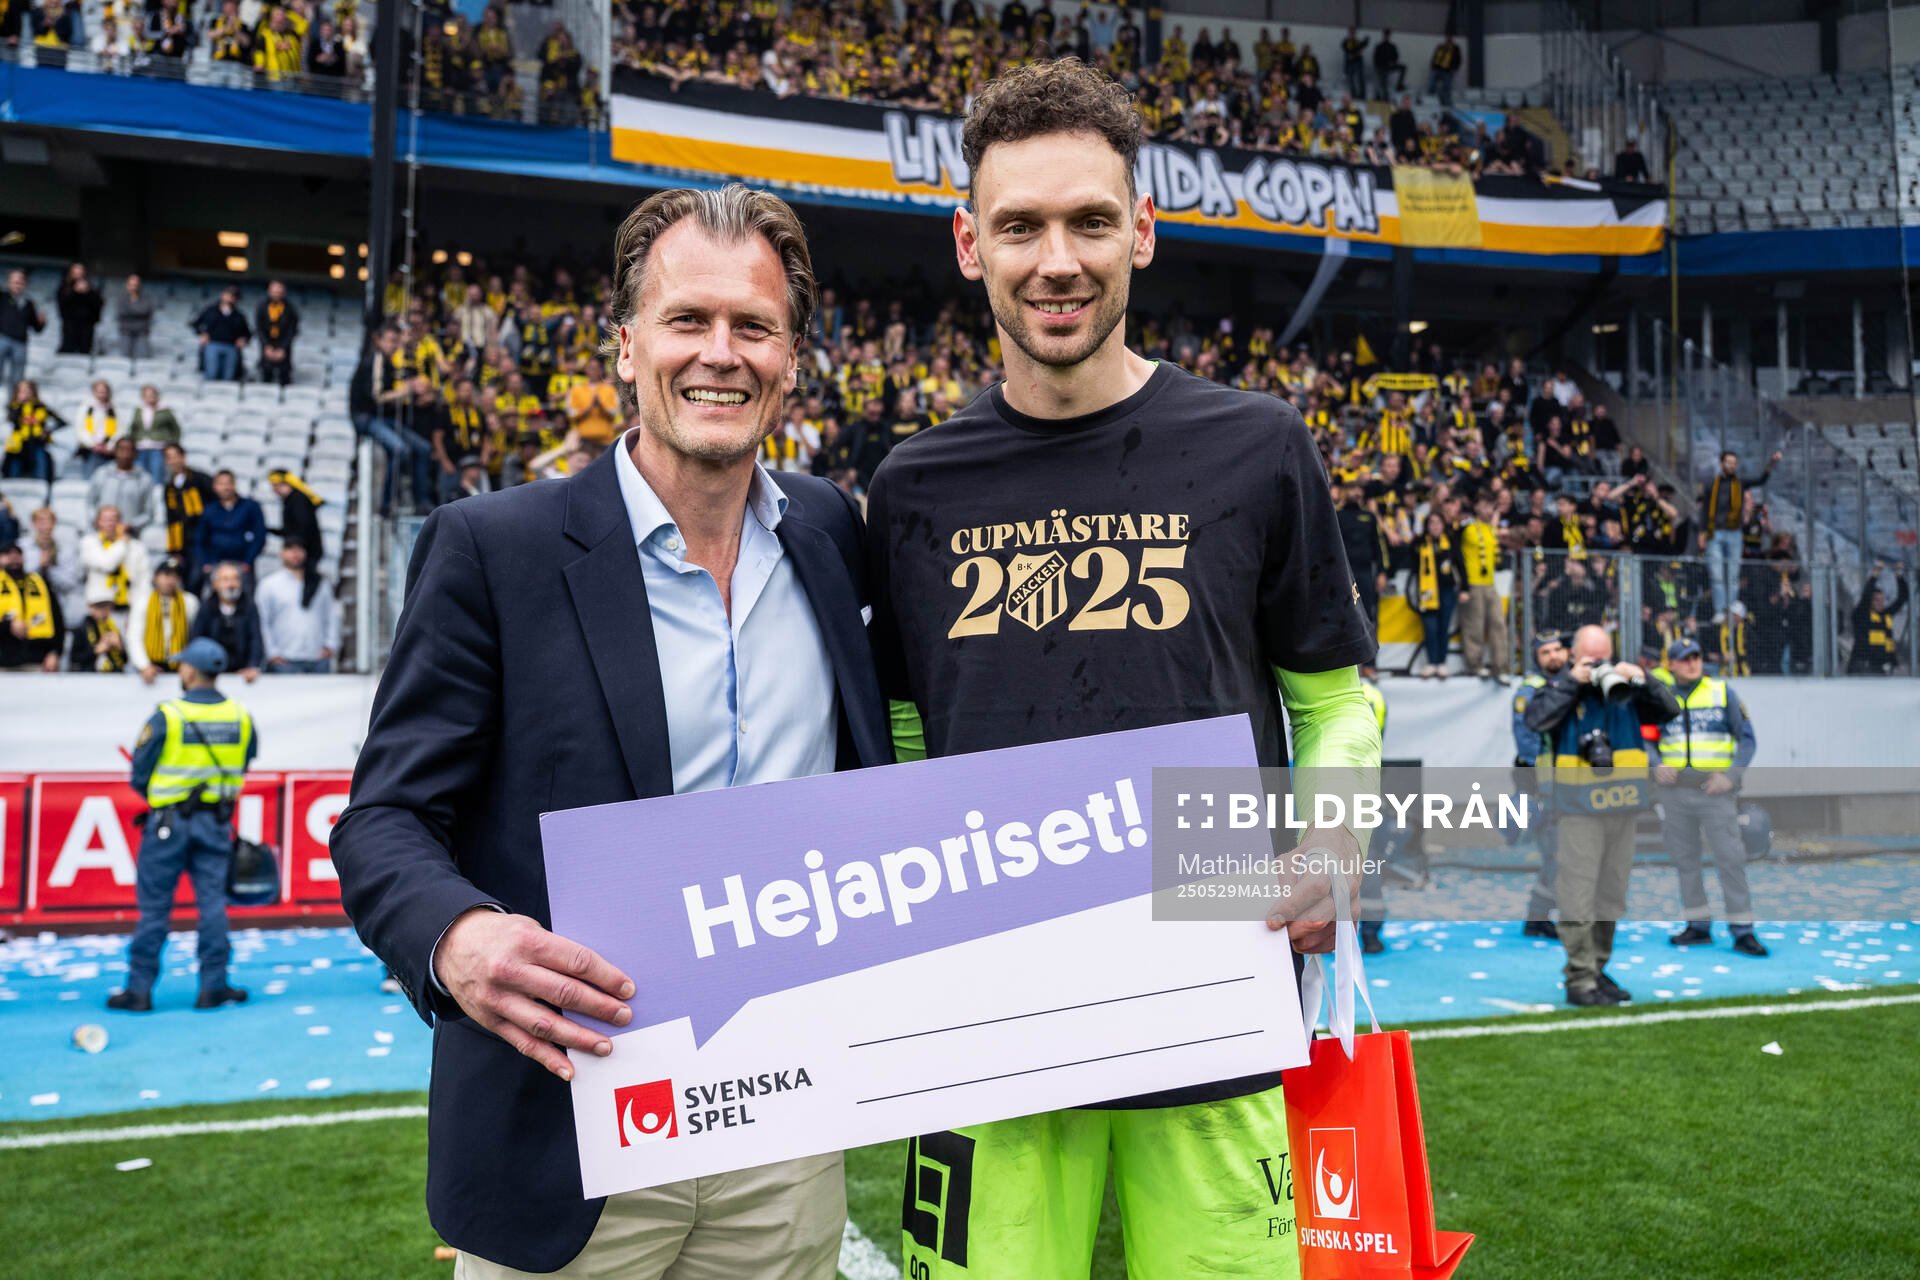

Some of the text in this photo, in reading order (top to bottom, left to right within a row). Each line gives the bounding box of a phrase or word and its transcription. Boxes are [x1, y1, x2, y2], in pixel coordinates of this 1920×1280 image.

[1242, 157, 1379, 234] COPA!
[951, 509, 1190, 554] CUPMÄSTARE
[1012, 560, 1060, 604] HÄCKEN
[1590, 784, 1640, 810] 002
[682, 778, 1147, 959] Hejapriset!
[684, 1068, 813, 1109] SVENSKA
[688, 1104, 755, 1135] SPEL
[1301, 1227, 1398, 1254] SVENSKA SPEL
